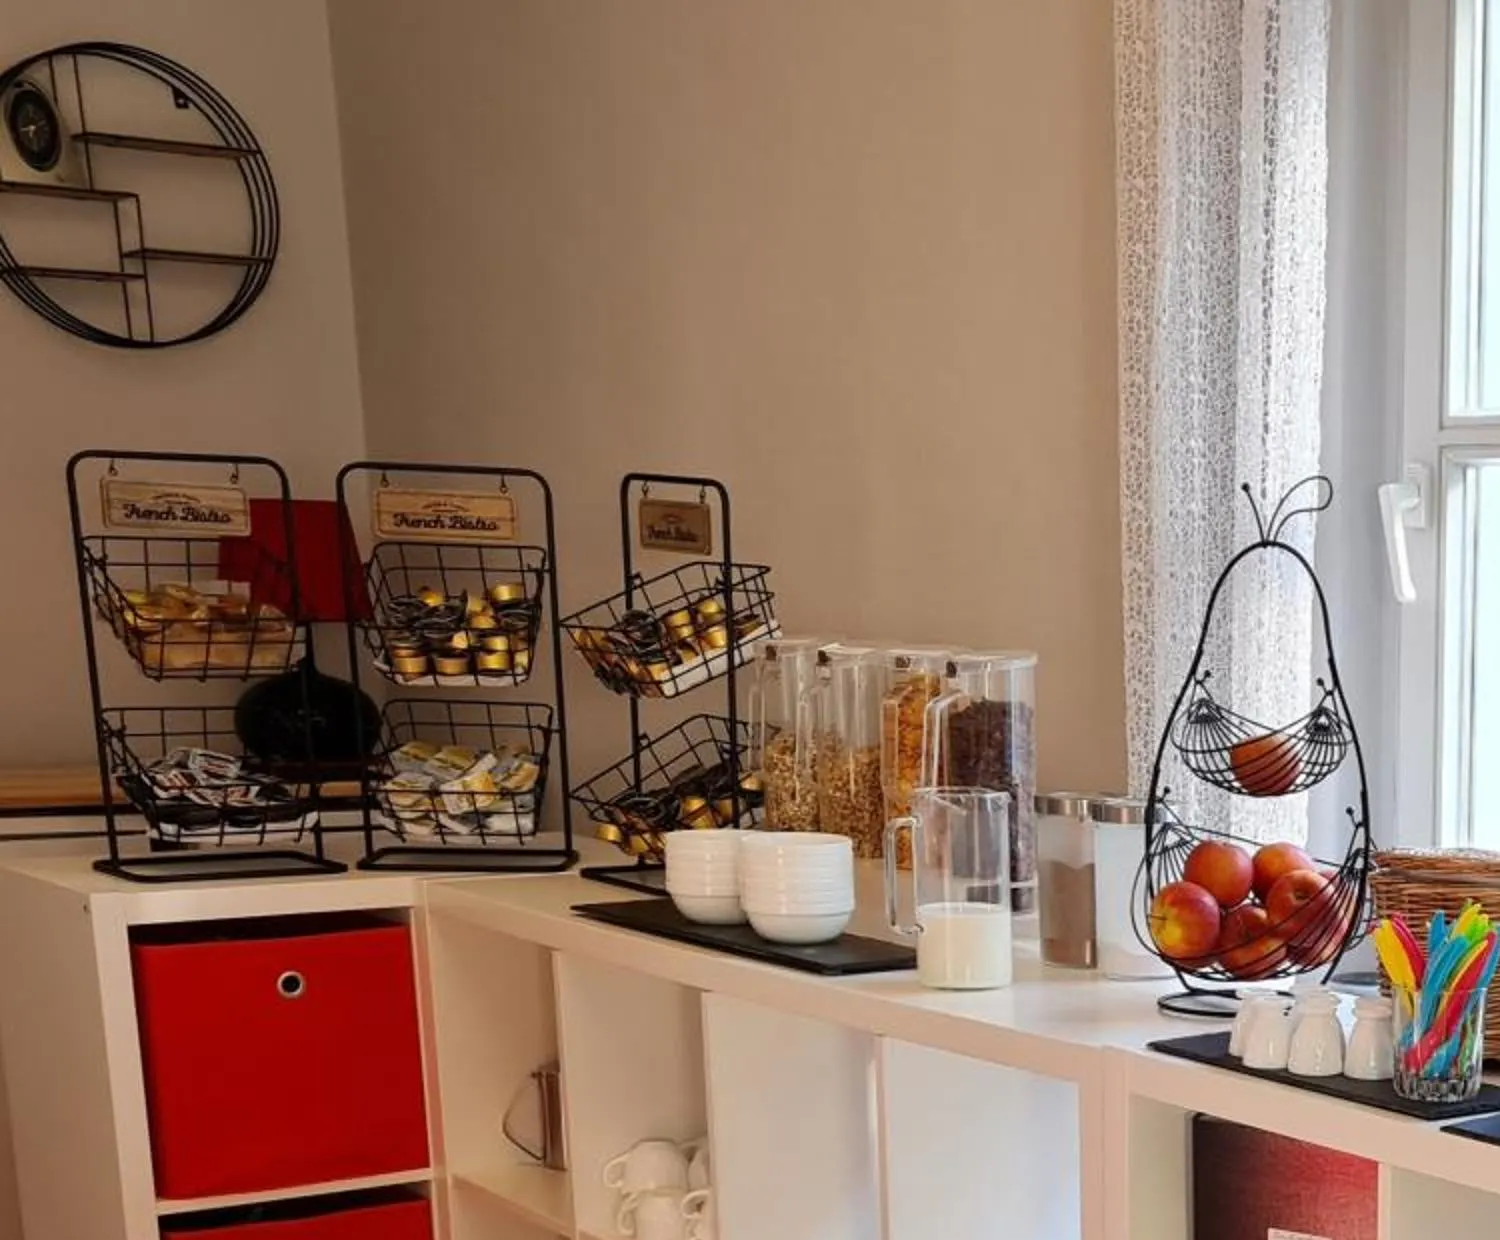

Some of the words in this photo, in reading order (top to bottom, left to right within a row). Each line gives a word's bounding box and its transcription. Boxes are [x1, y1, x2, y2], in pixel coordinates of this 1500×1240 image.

[122, 503, 177, 521] French
[180, 507, 232, 524] Bistro
[393, 512, 445, 529] French
[447, 515, 498, 531] Bistro
